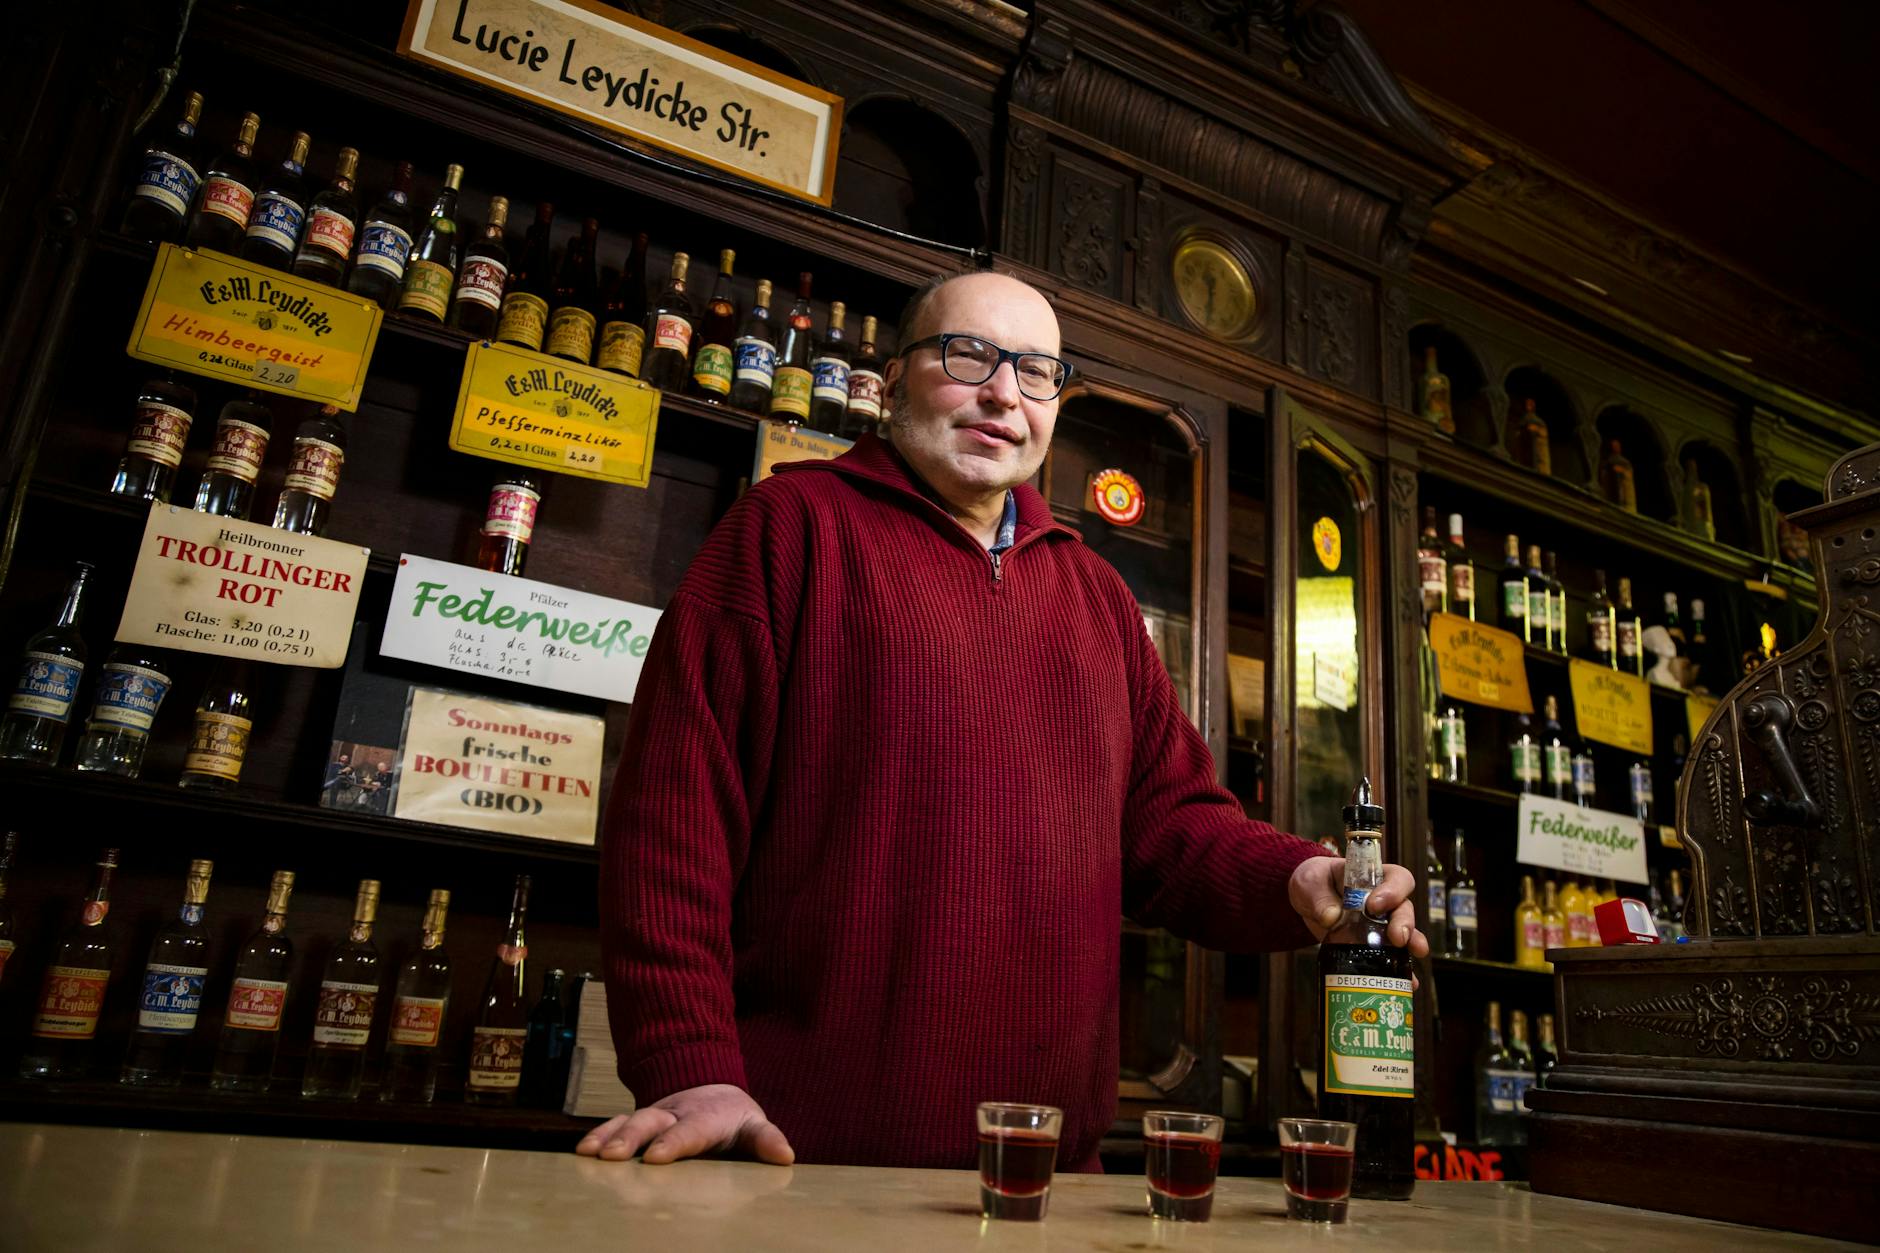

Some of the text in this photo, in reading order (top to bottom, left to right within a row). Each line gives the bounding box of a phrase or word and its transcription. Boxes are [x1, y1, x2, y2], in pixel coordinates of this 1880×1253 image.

[452, 0, 770, 157] Lucie Leydicke Str.
[224, 357, 254, 373] Glas
[219, 528, 305, 557] Heilbronner
[156, 535, 352, 593] TROLLINGER
[216, 578, 283, 608] ROT
[155, 623, 216, 643] Flasche:
[184, 610, 222, 627] Glas:
[447, 708, 572, 745] Sonntags
[461, 736, 552, 767] frische
[413, 754, 592, 798] BOULETTEN
[460, 788, 543, 816] (BIO)
[1529, 810, 1639, 853] Federweißer
[1337, 976, 1393, 988] DEUTSCHES
[1331, 993, 1352, 1003] SEIT
